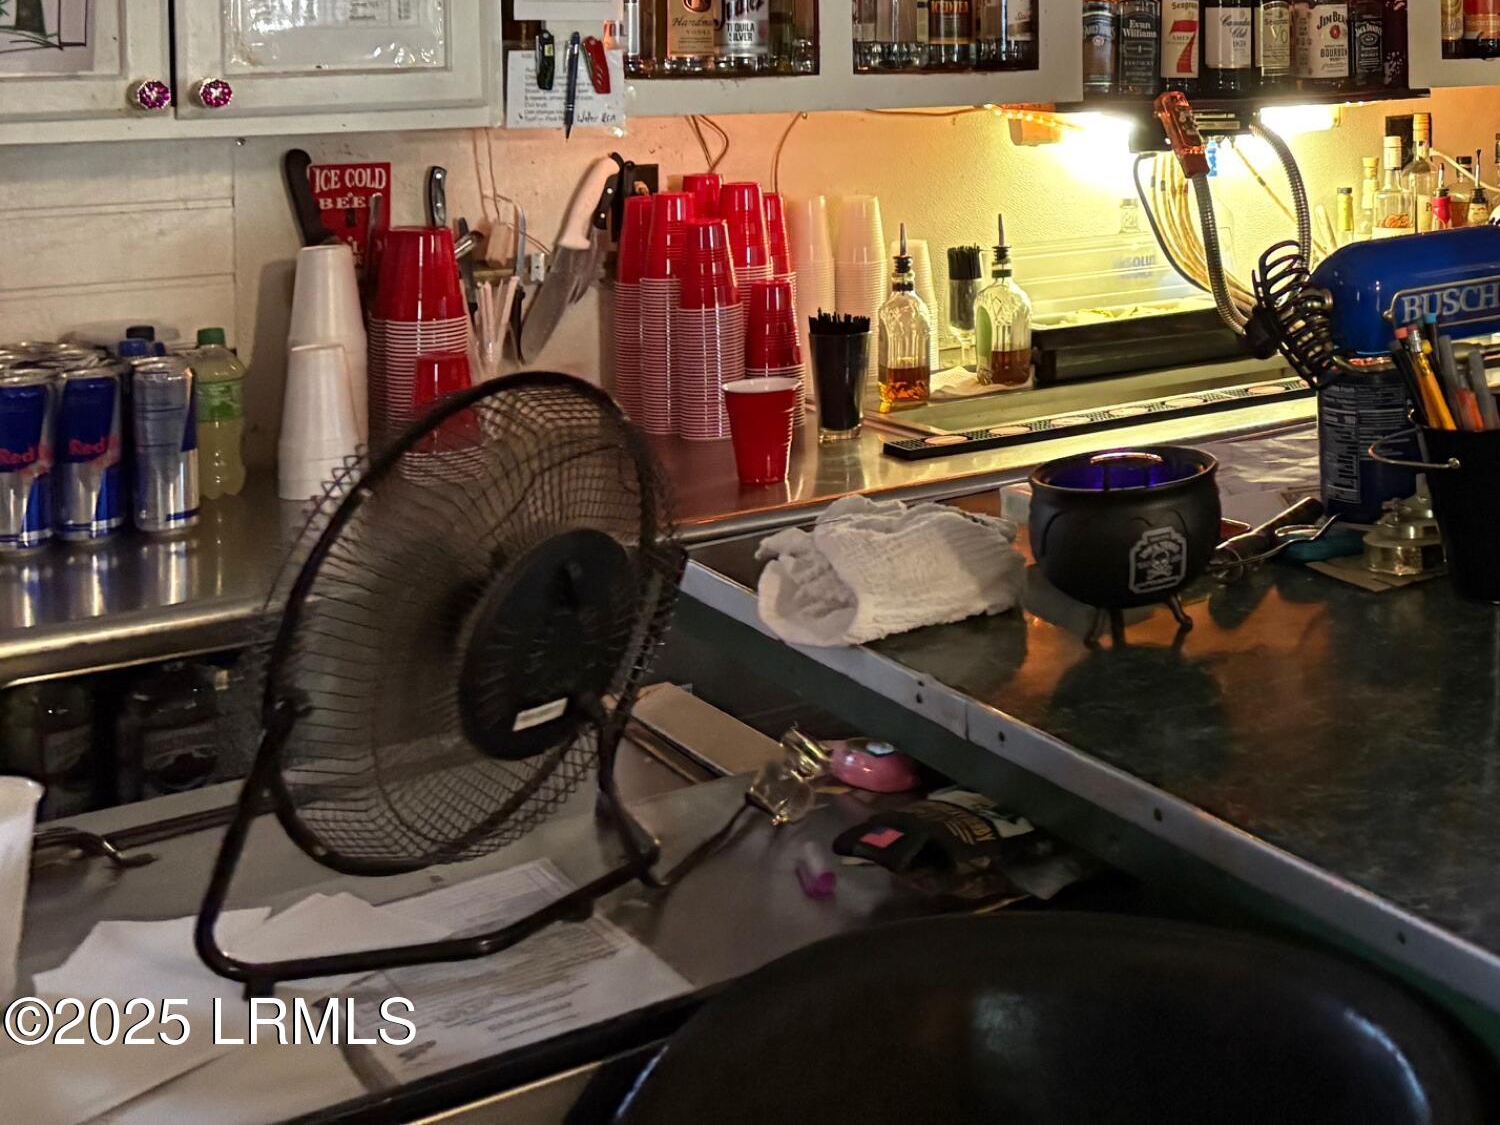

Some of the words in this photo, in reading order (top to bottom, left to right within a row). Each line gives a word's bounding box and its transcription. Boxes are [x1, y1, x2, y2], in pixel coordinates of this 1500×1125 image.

[1316, 14, 1332, 30] JIM
[1333, 11, 1348, 24] BEA
[313, 167, 341, 194] ICE
[345, 167, 387, 190] COLD
[319, 196, 367, 210] BEE
[1402, 280, 1500, 324] BUSCH
